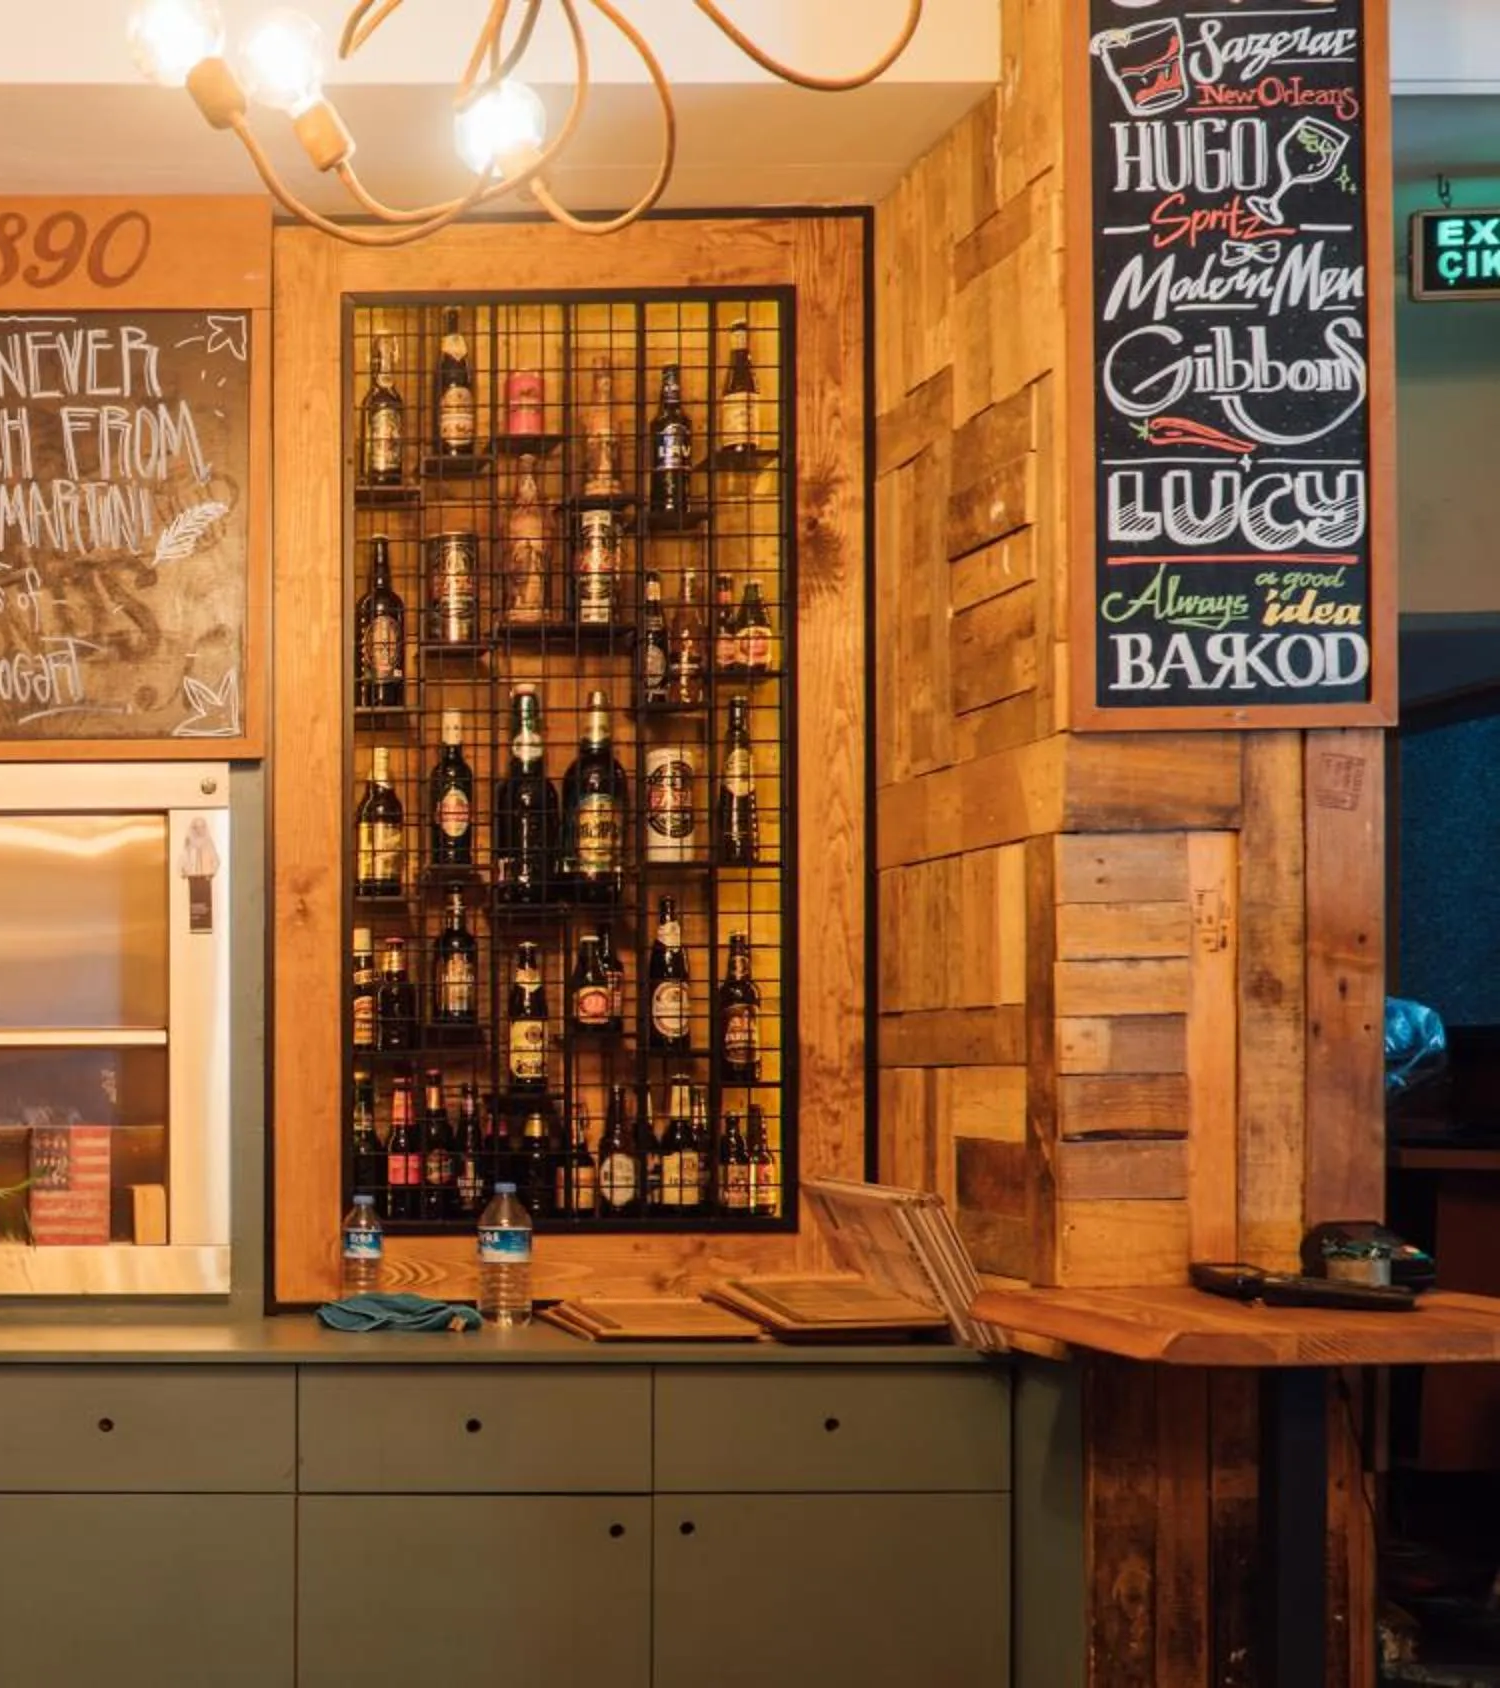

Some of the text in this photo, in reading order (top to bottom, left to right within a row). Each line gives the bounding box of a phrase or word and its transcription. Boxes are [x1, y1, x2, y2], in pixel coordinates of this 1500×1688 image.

[1196, 77, 1359, 121] New Orleans
[1110, 117, 1269, 193] HUGO
[1150, 193, 1297, 249] Spritz
[1103, 241, 1365, 321] Modern Men
[60, 401, 212, 486] FROM
[1107, 470, 1367, 551] LUCY
[17, 567, 42, 632] of
[1101, 563, 1346, 629] Always a good
[1262, 589, 1362, 627] idea
